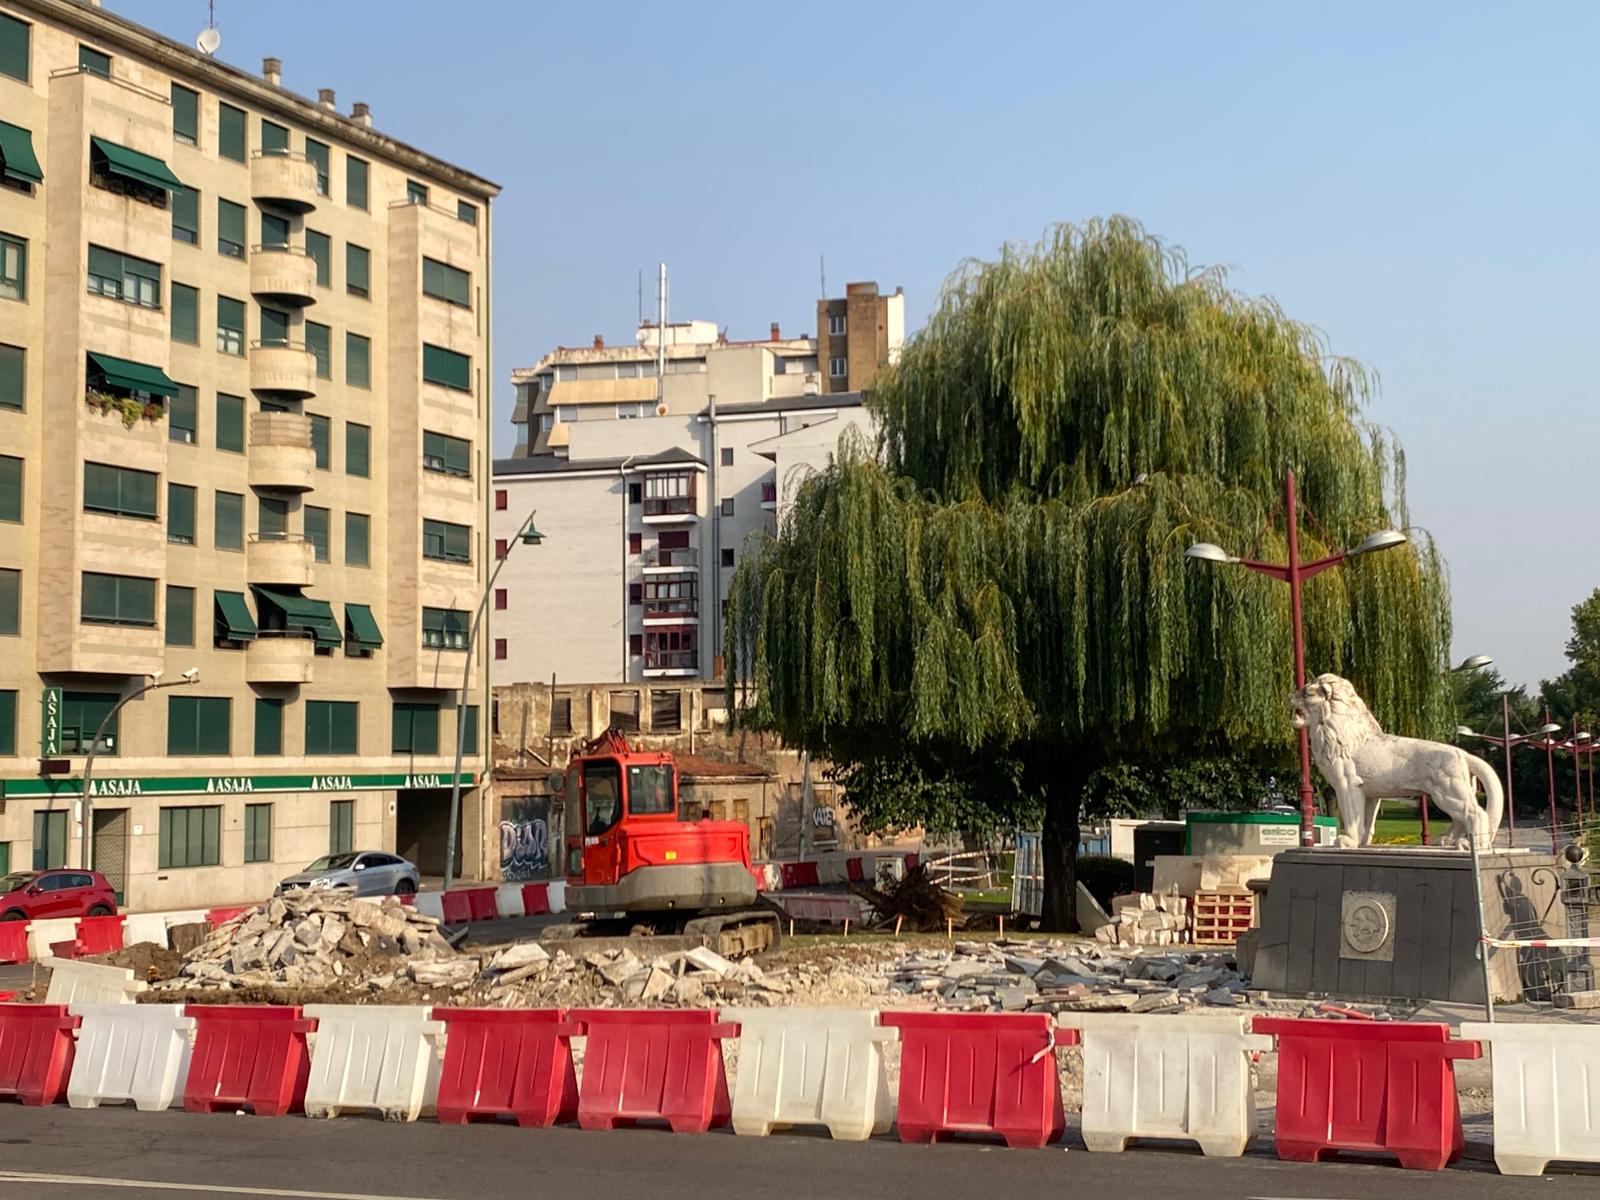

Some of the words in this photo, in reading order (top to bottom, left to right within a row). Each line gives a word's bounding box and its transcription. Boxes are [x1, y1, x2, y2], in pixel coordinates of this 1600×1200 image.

[46, 690, 58, 754] ASAJA
[99, 780, 142, 796] ASAJA
[216, 778, 254, 793] ASAJA
[319, 776, 352, 790] ASAJA
[412, 774, 441, 788] ASAJA
